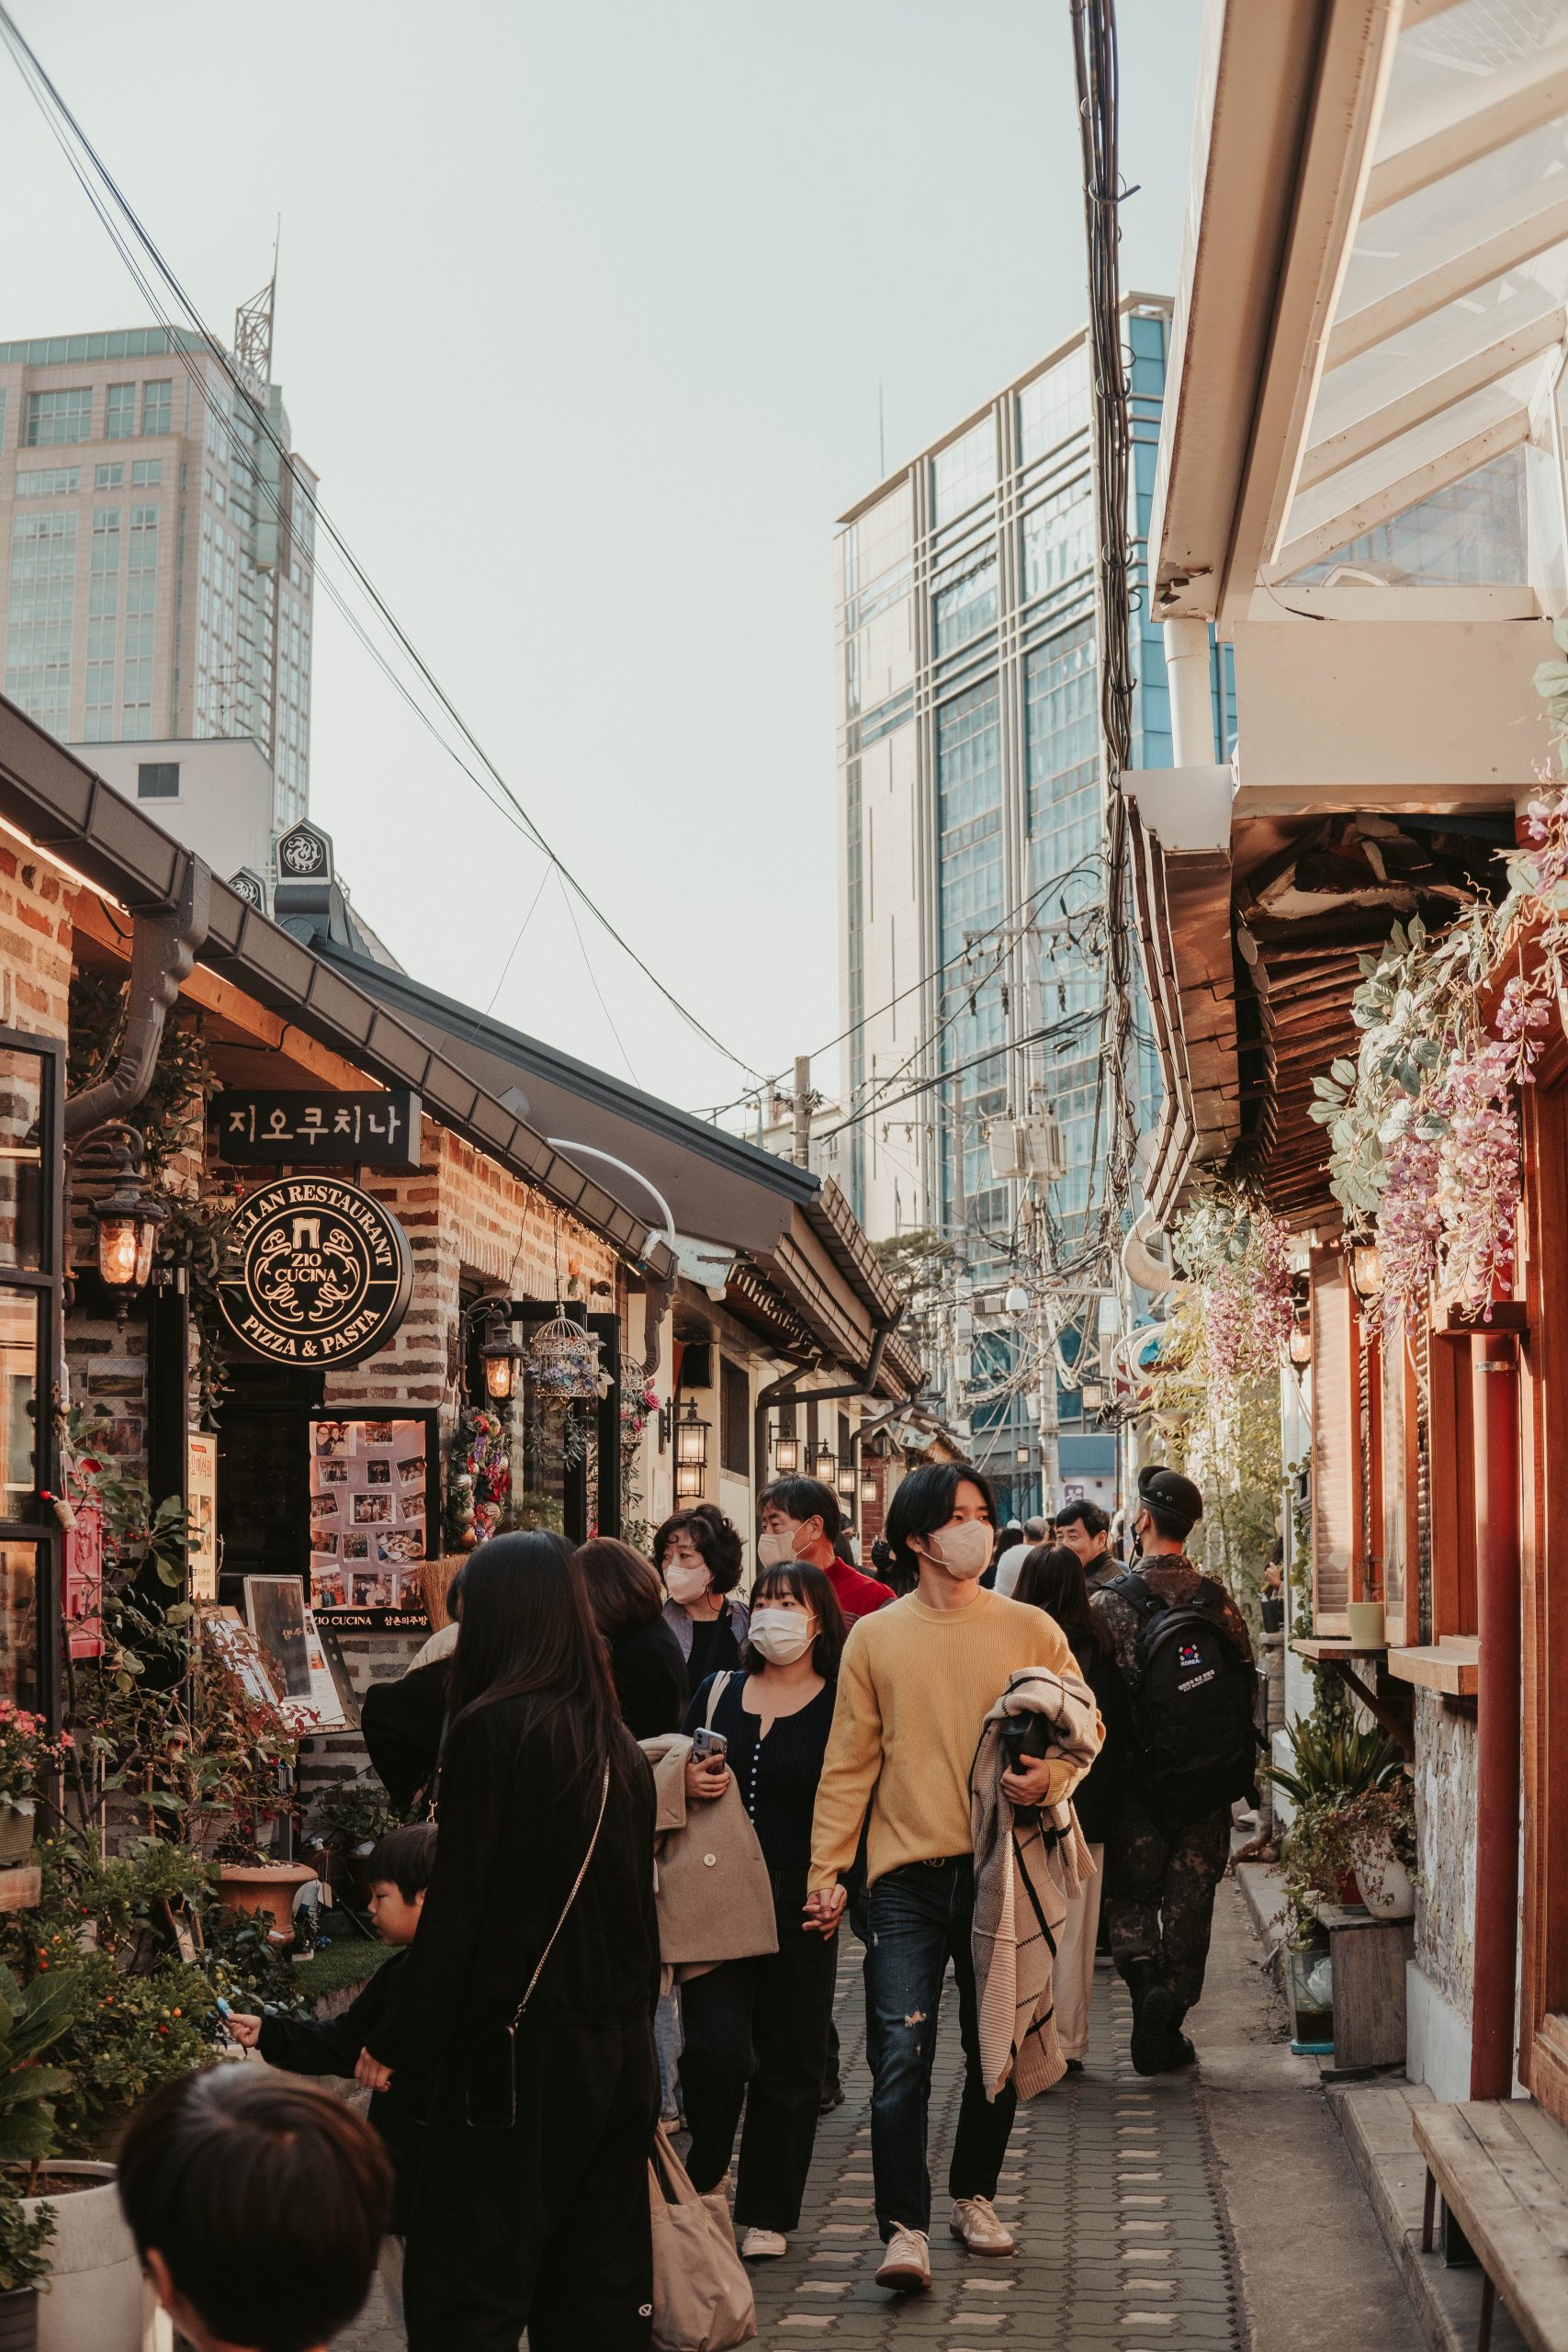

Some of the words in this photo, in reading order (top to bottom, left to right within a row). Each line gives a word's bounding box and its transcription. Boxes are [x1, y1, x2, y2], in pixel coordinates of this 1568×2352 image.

[228, 1103, 401, 1146] 지오쿠치나
[288, 1183, 393, 1268] RESTAURANT
[291, 1253, 321, 1268] ZIO
[275, 1268, 338, 1283] CUCINA
[241, 1314, 297, 1357] PIZZA
[301, 1340, 318, 1357] &
[321, 1308, 380, 1355] PASTA
[332, 1616, 372, 1625] CUCINA
[384, 1615, 429, 1626] 삼촌의주방
[1180, 1658, 1201, 1667] KOREA
